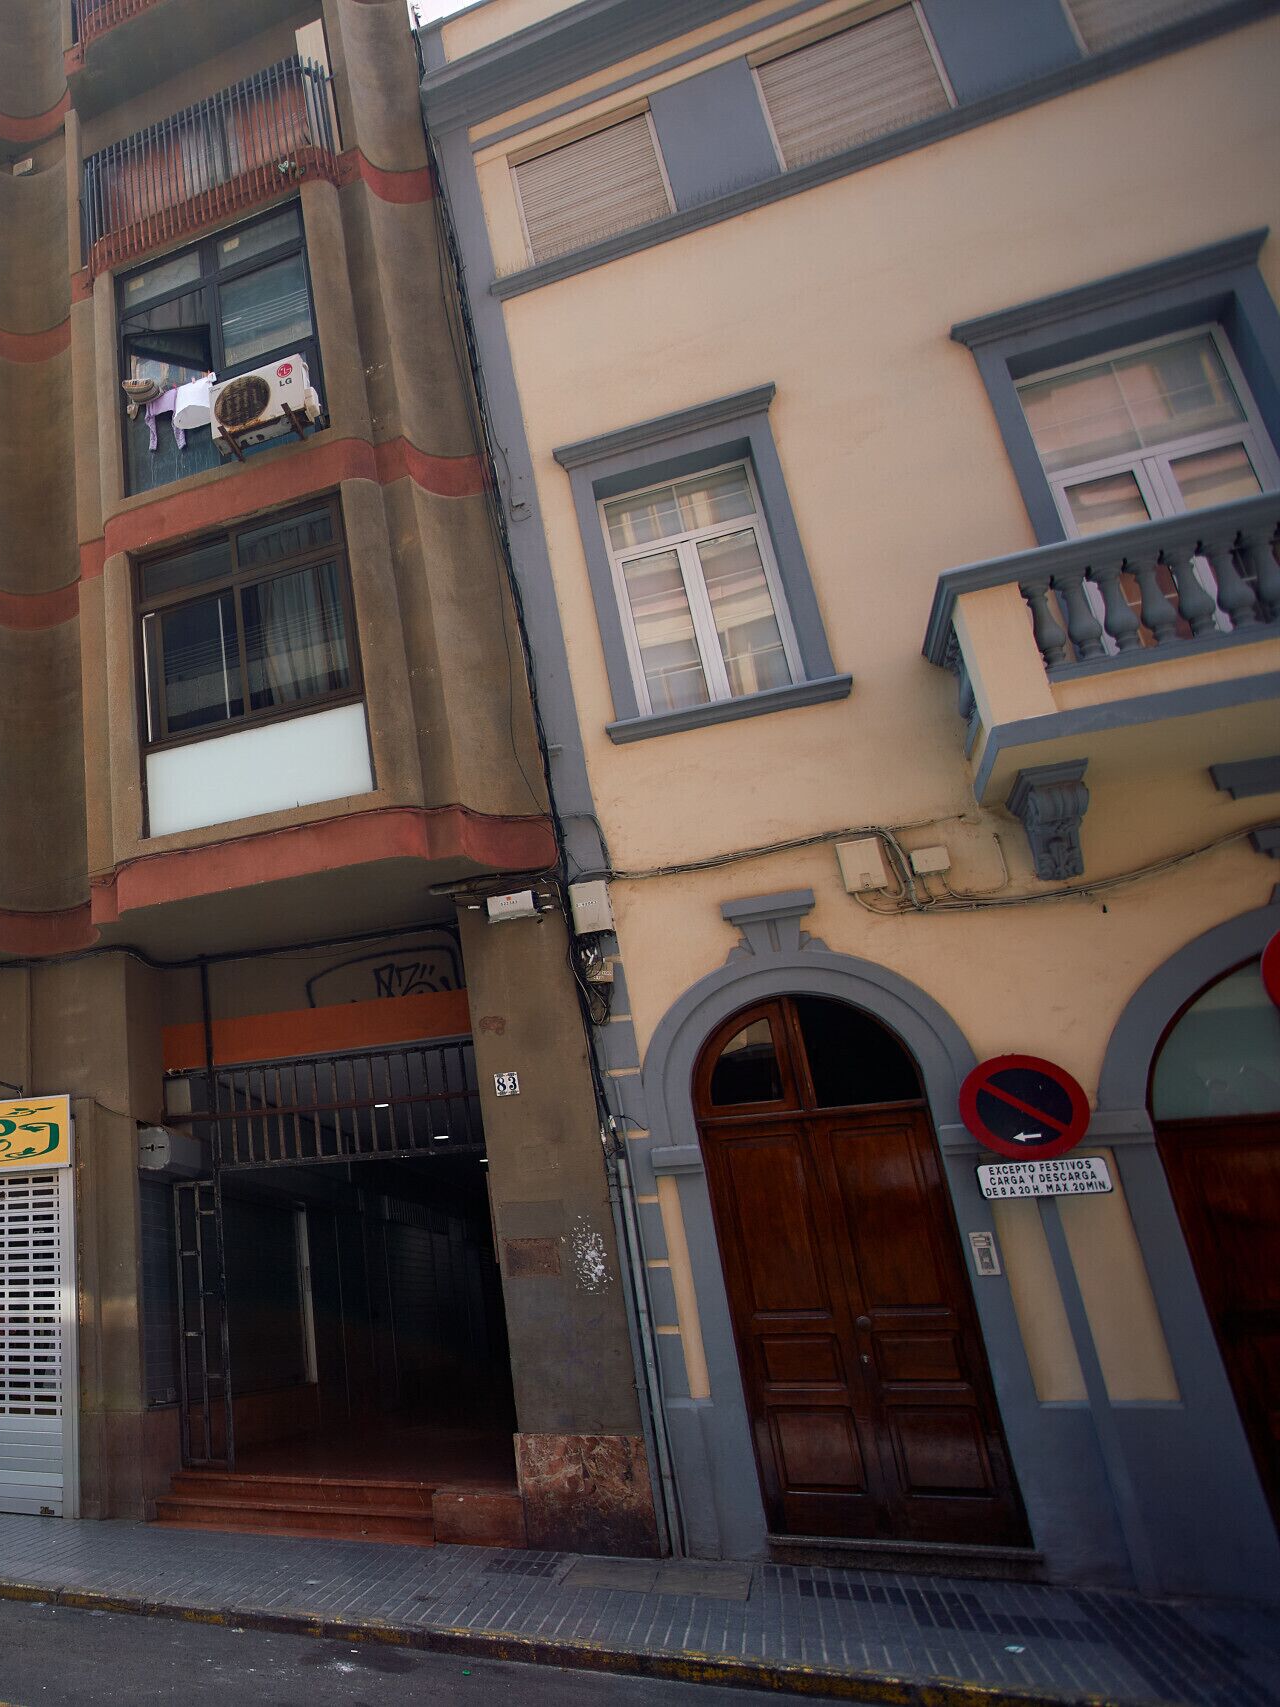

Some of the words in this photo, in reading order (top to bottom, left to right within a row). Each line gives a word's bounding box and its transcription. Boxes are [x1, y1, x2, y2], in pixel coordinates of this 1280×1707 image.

[279, 377, 292, 387] LG
[496, 1076, 518, 1092] 83
[988, 1164, 1035, 1176] EXCEPTO
[1039, 1160, 1092, 1172] FESTIVOS
[990, 1175, 1025, 1186] CARGA
[1029, 1174, 1034, 1183] Y
[1039, 1170, 1097, 1183] DESCARGA
[986, 1187, 999, 1197] DE
[1001, 1187, 1007, 1196] 8
[1009, 1186, 1016, 1195] A
[1020, 1185, 1031, 1195] 20
[1033, 1184, 1043, 1194] H.
[1086, 1180, 1109, 1190] MIN.
